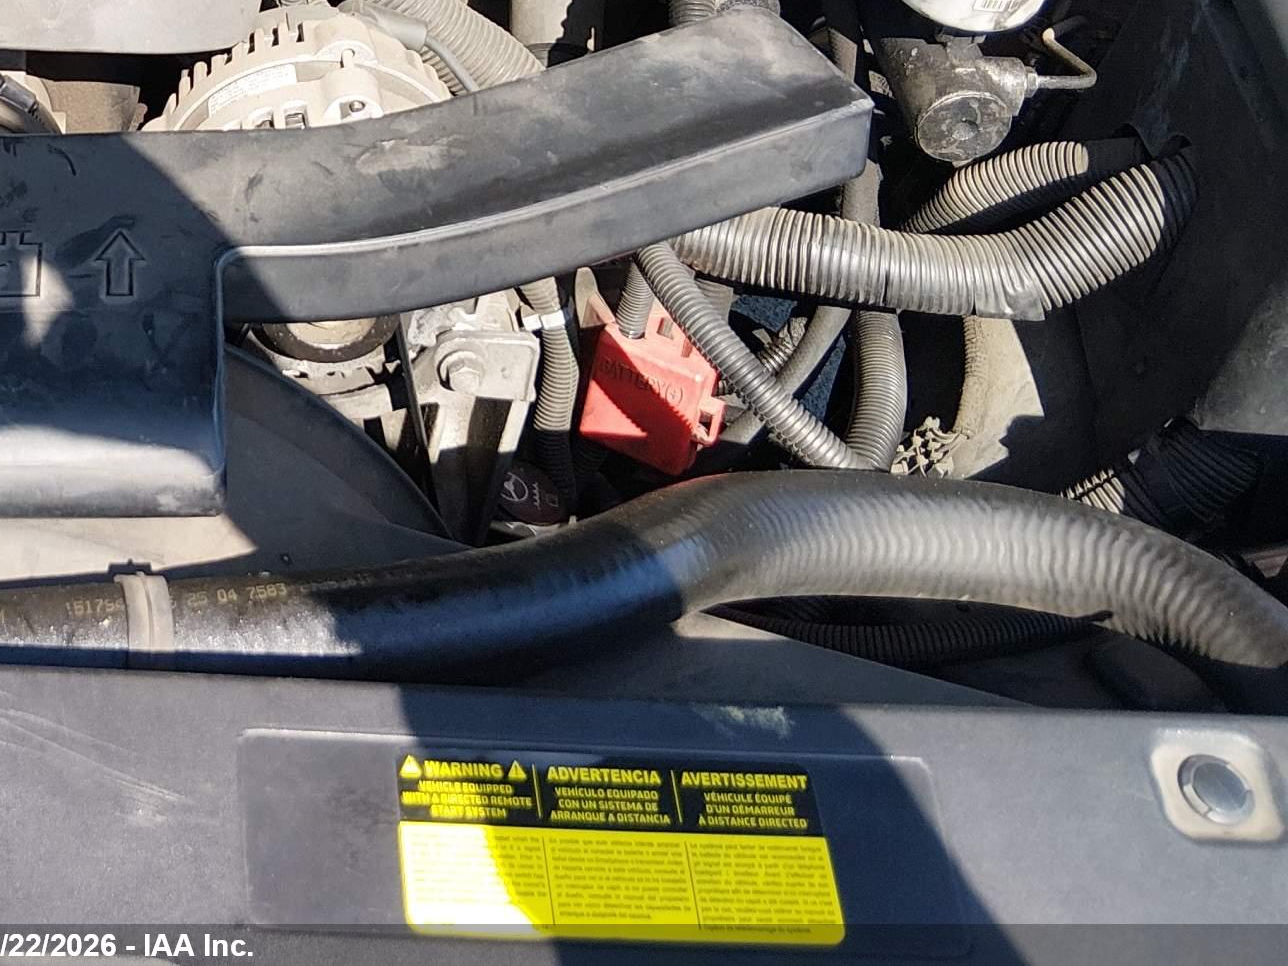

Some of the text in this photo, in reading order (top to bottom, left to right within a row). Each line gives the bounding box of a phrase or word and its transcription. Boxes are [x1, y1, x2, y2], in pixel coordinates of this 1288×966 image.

[216, 588, 238, 603] 04
[246, 583, 288, 601] 7583
[423, 760, 503, 778] WARNING
[547, 766, 661, 783] ADVERTENCIA
[418, 780, 513, 794] VEHICLE EQUIPPED
[681, 771, 808, 789] AVERTISSEMENT
[401, 791, 532, 807] WITH A DIRECTED REMOTE
[555, 786, 659, 800] VEHÍCULO EQUIPADO
[703, 792, 792, 804] VÉHICULE ÉQUIPÉ
[430, 805, 507, 819] START SYSTEM
[558, 798, 659, 812] CON UN SISTEMA DE
[706, 803, 795, 816] D'UN DÉMARREUR
[550, 810, 671, 825] ARRANQUE A DISTANCIA
[708, 815, 757, 827] DISTANCE
[758, 817, 808, 829] DIRECTED
